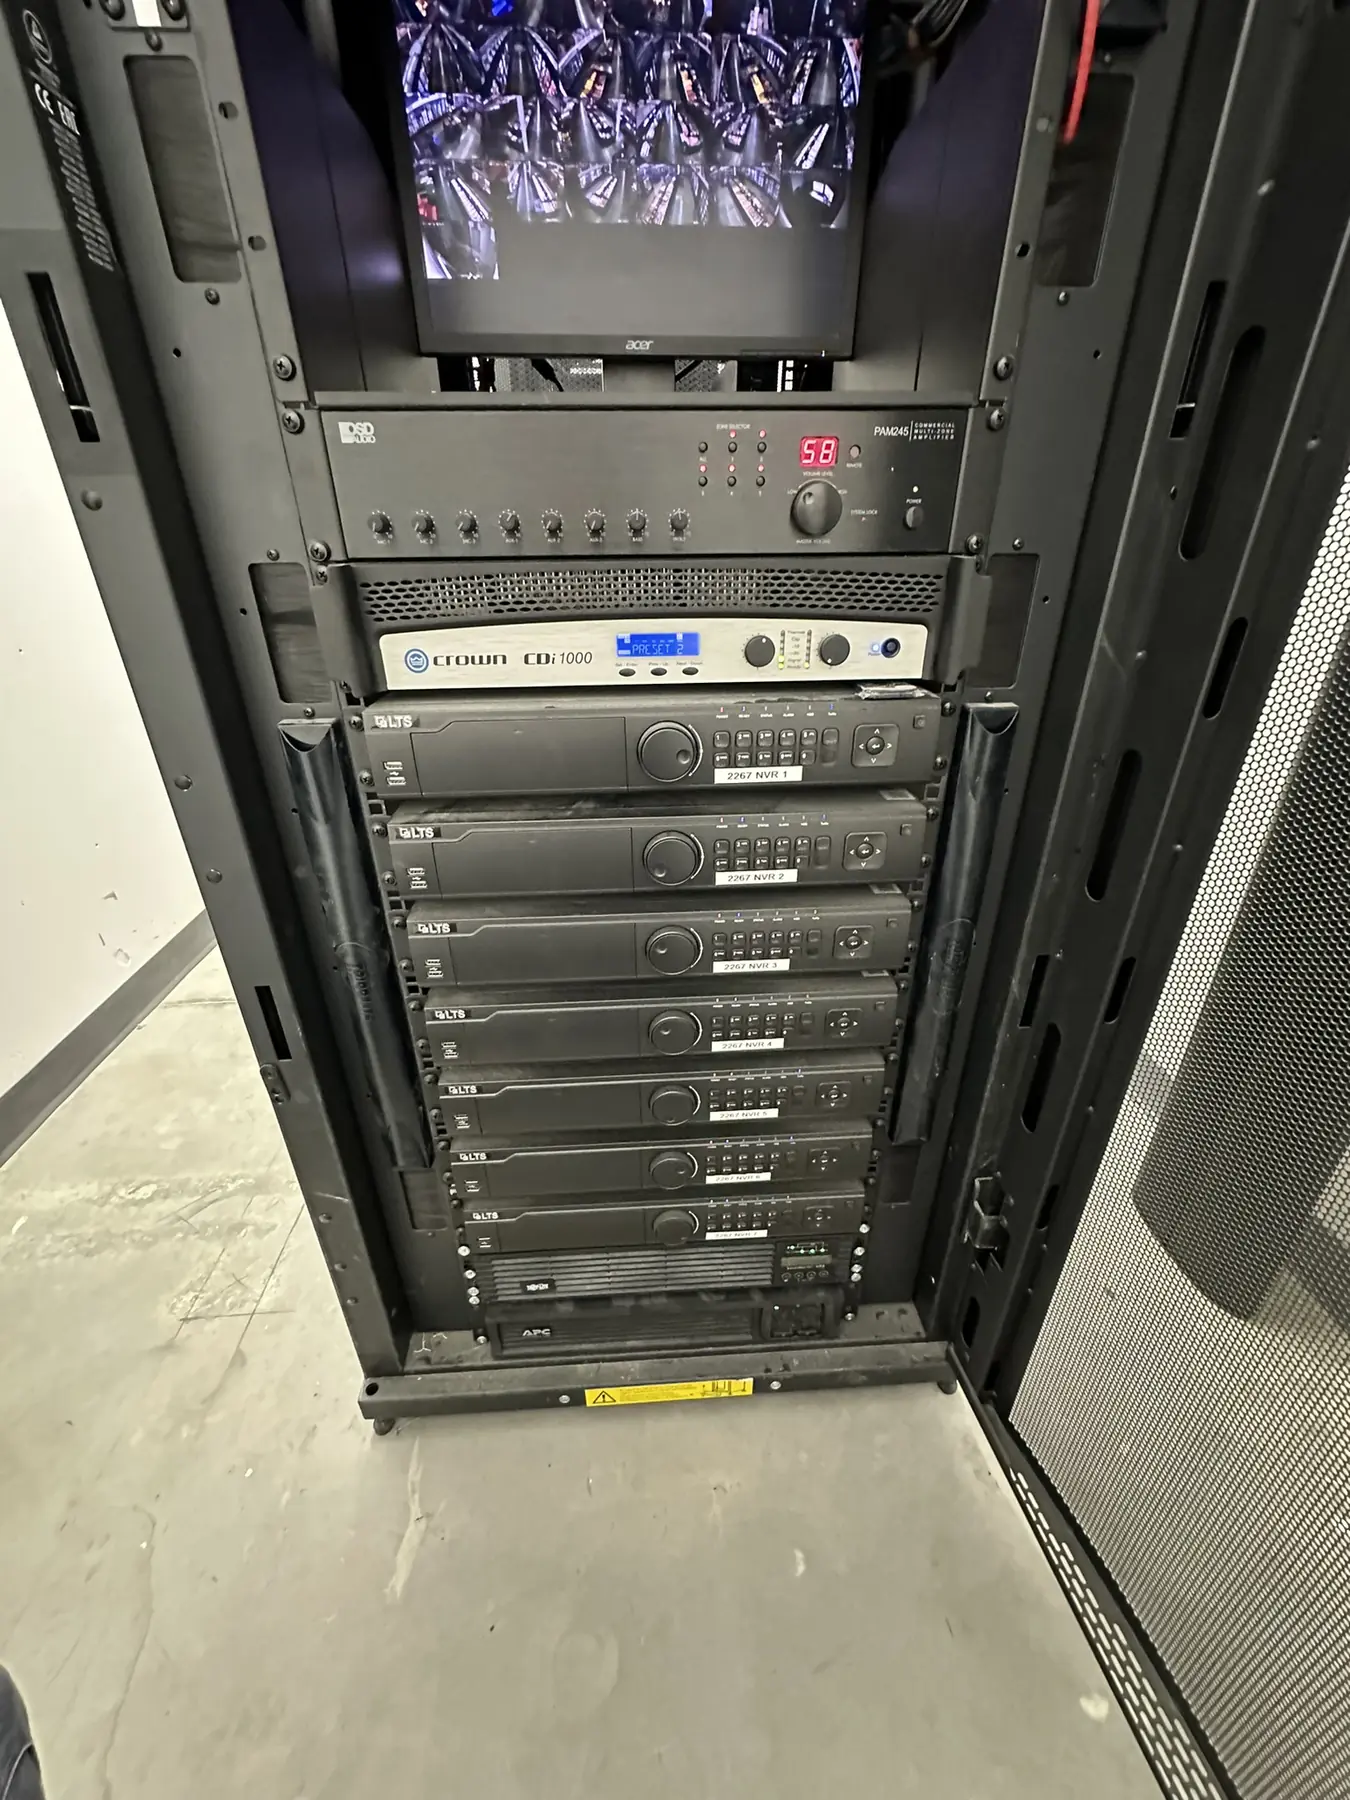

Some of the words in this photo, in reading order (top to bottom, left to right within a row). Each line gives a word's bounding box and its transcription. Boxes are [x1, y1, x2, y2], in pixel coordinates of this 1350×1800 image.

[626, 340, 654, 350] acer
[873, 426, 909, 436] PAM245
[801, 440, 836, 464] 58
[632, 643, 671, 655] PRESET
[676, 643, 684, 655] 2
[433, 654, 507, 666] crown
[387, 714, 412, 729] LTS
[727, 771, 752, 780] 2267
[755, 771, 778, 779] NVR
[783, 770, 788, 778] 1
[410, 826, 435, 839] LTS
[728, 873, 750, 882] 2267
[753, 872, 775, 881] NVR
[428, 922, 450, 934] LTS
[748, 962, 769, 970] NVR
[445, 1009, 466, 1019] LTS
[459, 1085, 477, 1094] LTS
[469, 1152, 487, 1161] LTS
[481, 1211, 499, 1220] LTS
[522, 1329, 551, 1337] APC
